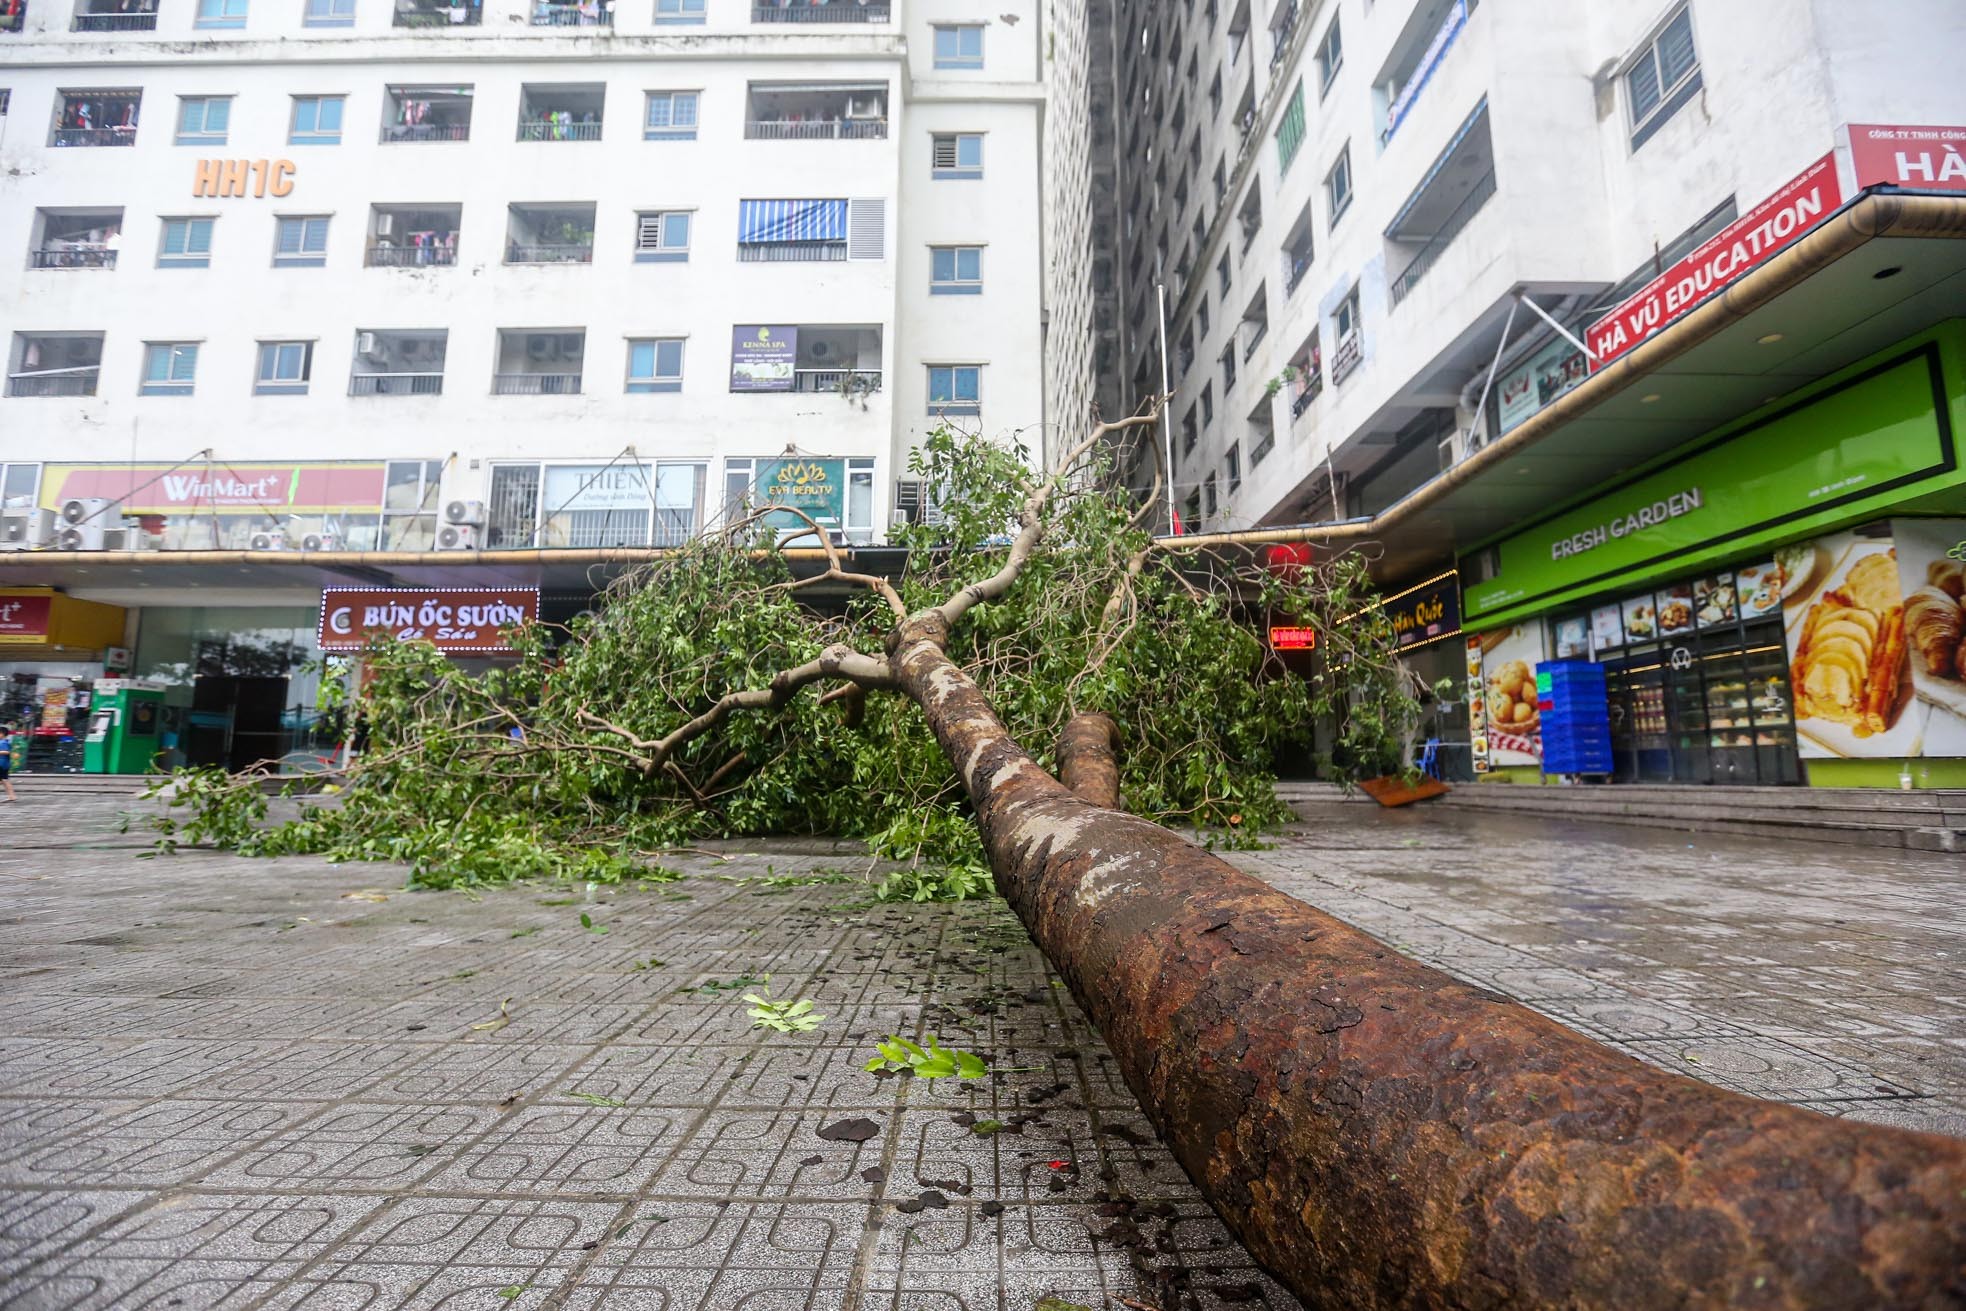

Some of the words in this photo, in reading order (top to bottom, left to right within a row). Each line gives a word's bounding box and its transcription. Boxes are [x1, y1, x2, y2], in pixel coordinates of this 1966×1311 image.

[1896, 131, 1909, 139] TY
[192, 160, 296, 198] HH1C
[1895, 143, 1966, 182] HÀ
[1597, 320, 1628, 359] HÀ
[1629, 294, 1661, 335] VŨ
[1665, 186, 1822, 314] EDUCATION
[793, 485, 833, 495] BEAUTY
[1552, 525, 1607, 561] FRESH
[1610, 487, 1703, 538] GARDEN
[363, 600, 415, 628] BÚN
[418, 599, 452, 628] ỐC
[456, 599, 526, 628] SƯỜN
[434, 627, 477, 641] Sáu
